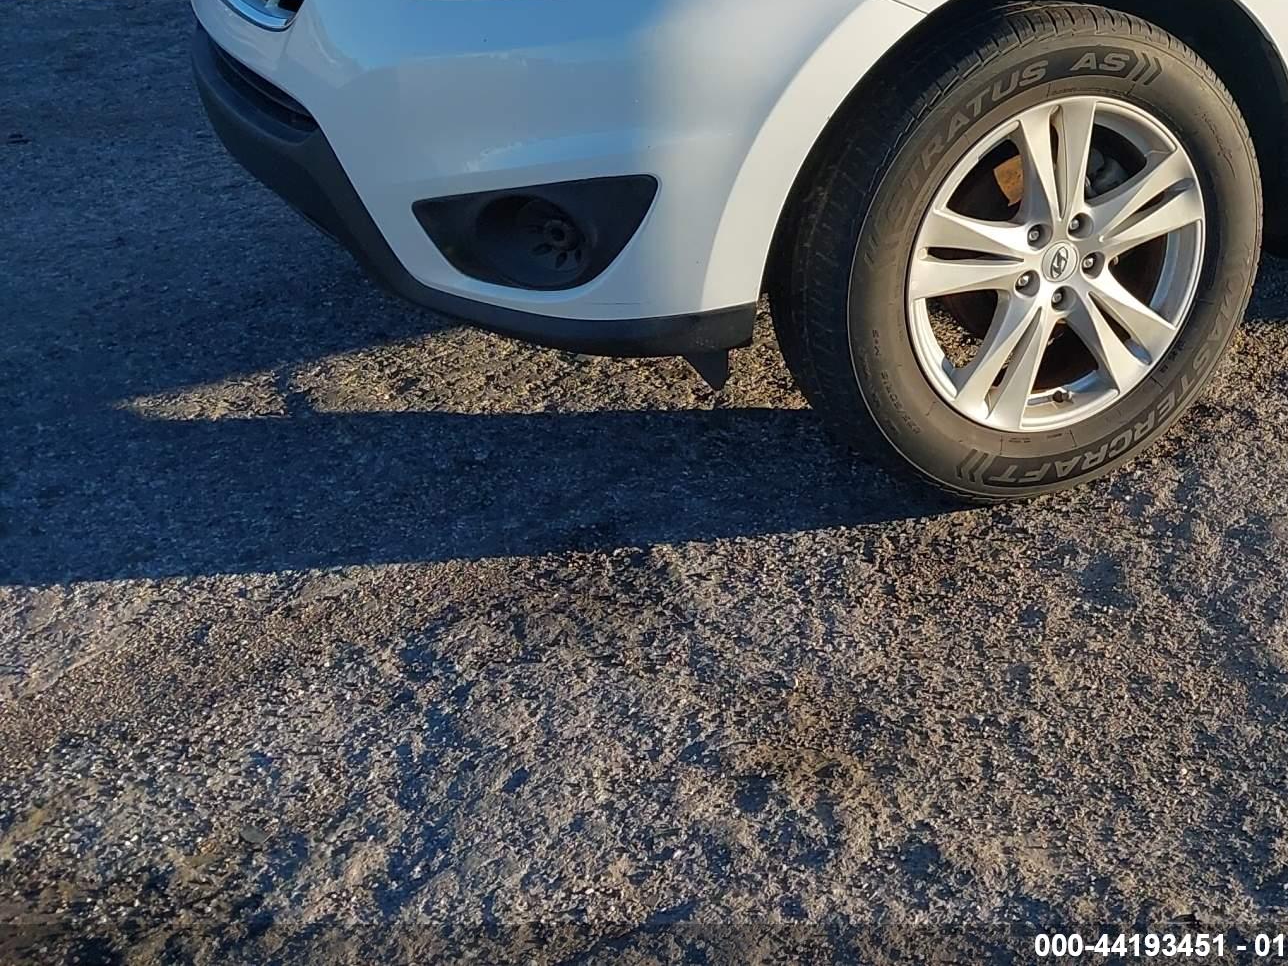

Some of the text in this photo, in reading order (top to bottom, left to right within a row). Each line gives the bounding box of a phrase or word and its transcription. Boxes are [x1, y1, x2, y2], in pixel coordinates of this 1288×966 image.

[883, 52, 1131, 227] STRATUS AS
[984, 278, 1233, 484] MASTERCRAFT
